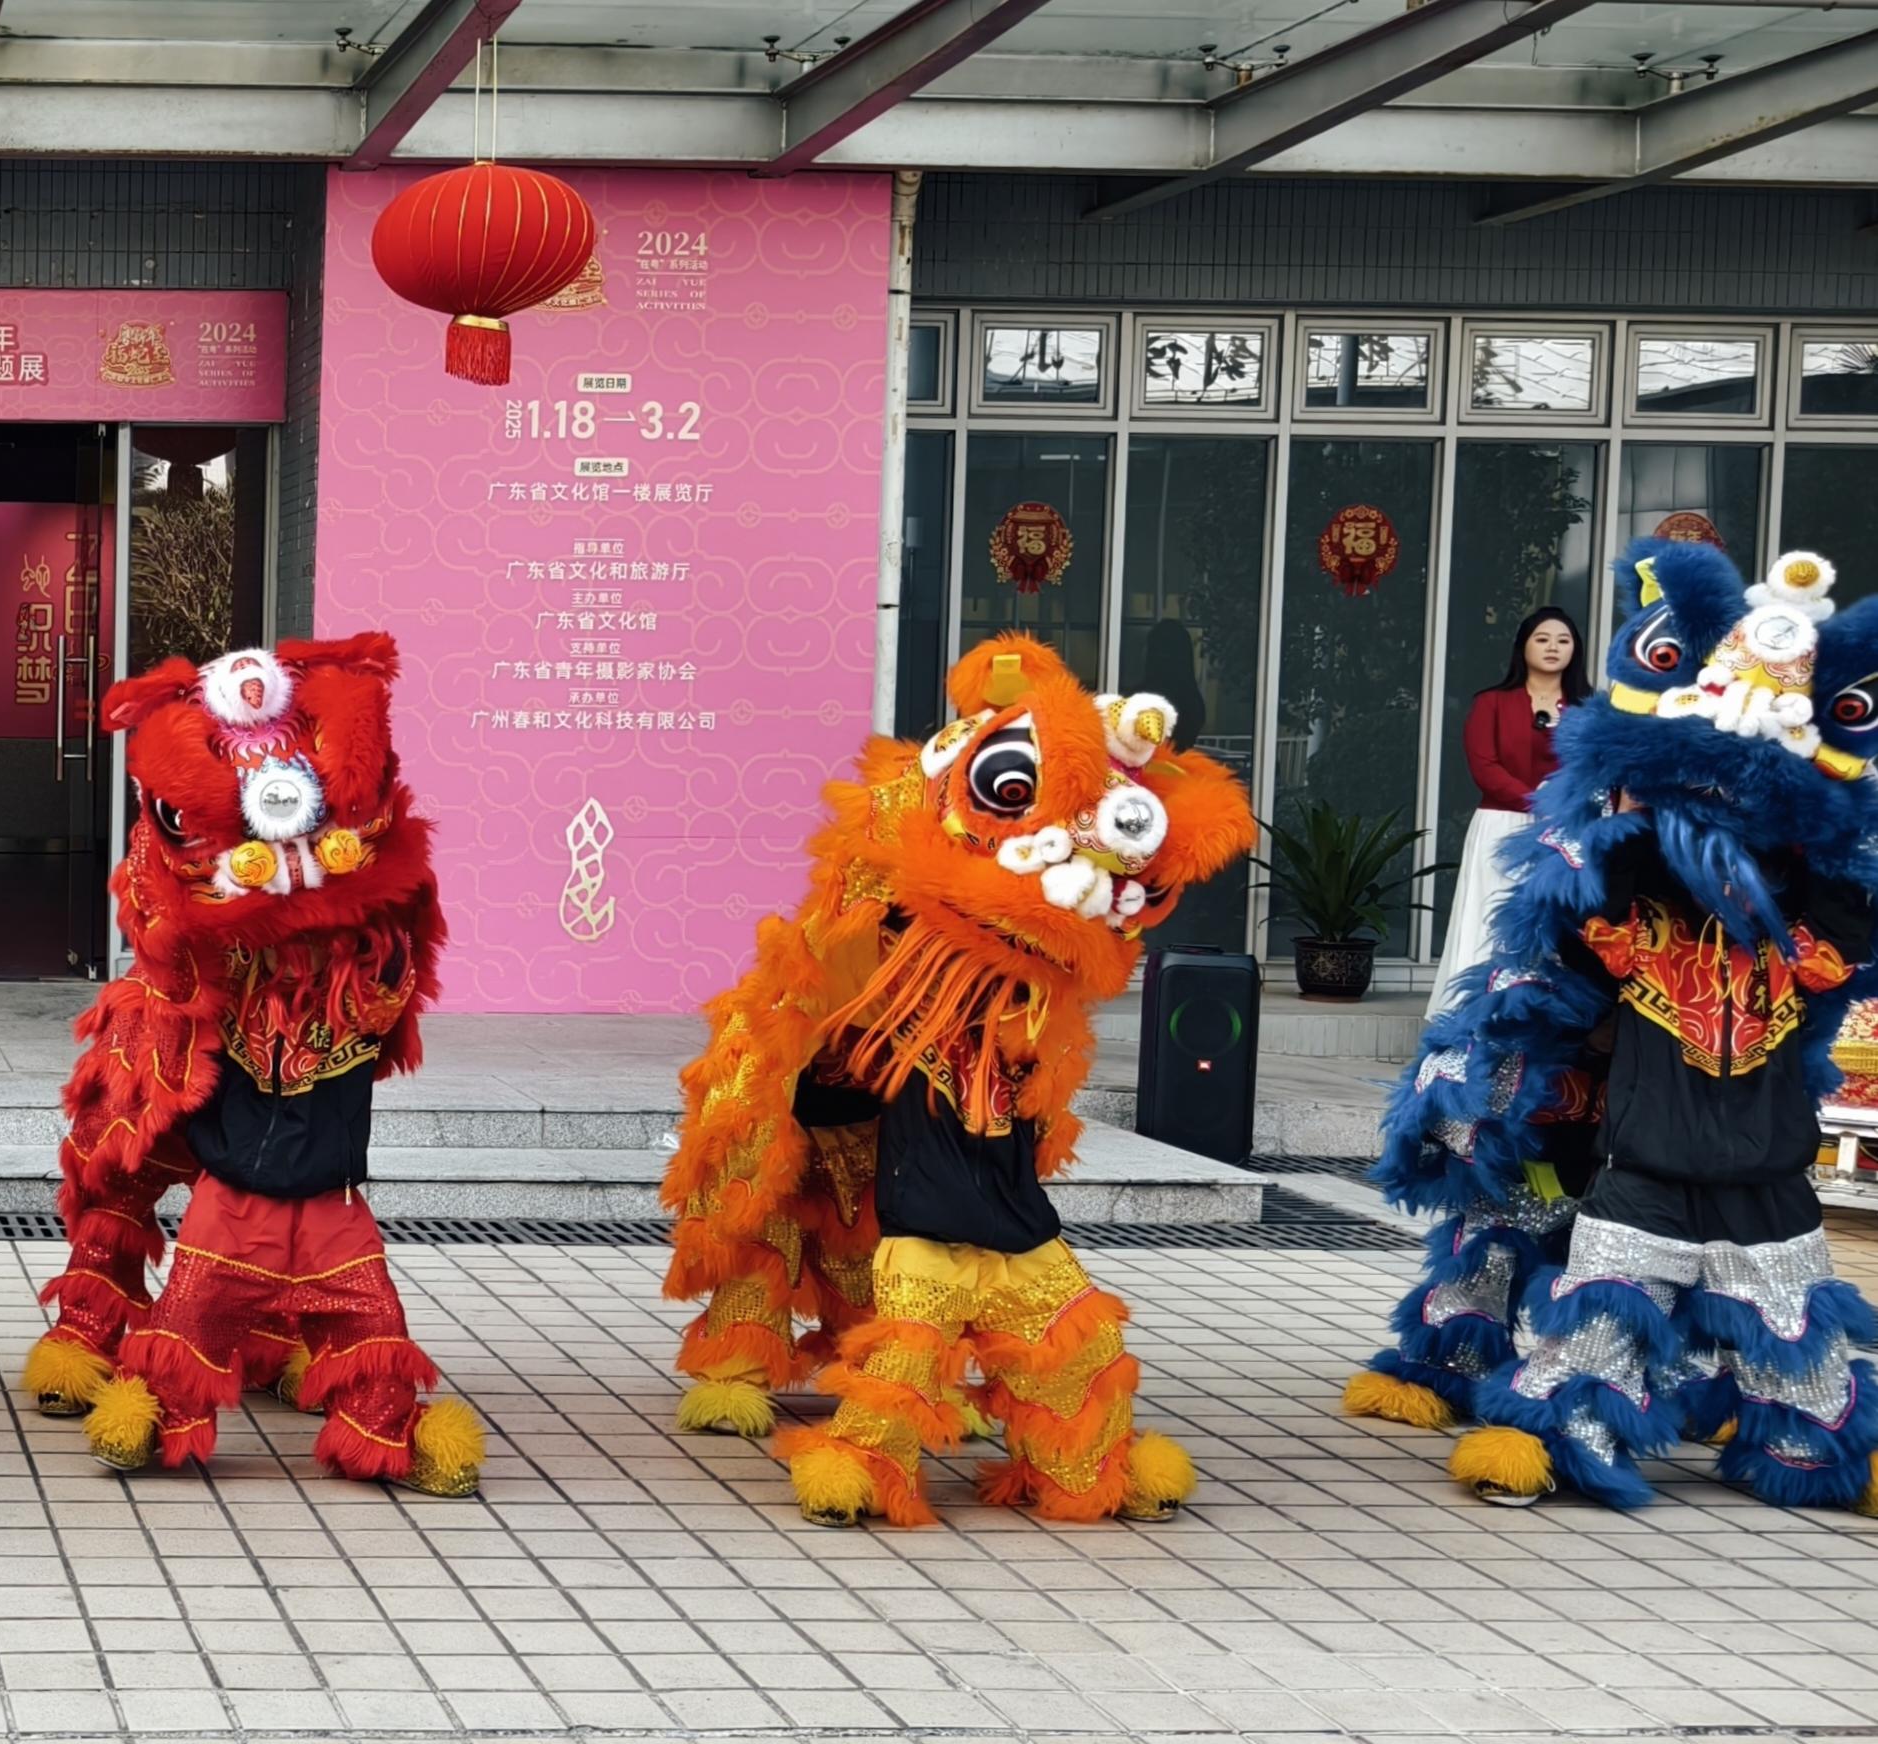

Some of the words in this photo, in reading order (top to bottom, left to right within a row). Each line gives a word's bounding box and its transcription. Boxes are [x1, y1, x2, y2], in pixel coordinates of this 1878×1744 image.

[637, 231, 708, 256] 2024
[636, 278, 657, 286] ZAI
[682, 278, 707, 286] YUE
[636, 290, 678, 298] SERIES
[689, 290, 706, 298] OF
[636, 302, 707, 310] ACTIVITIES
[199, 322, 257, 342] 2024
[583, 377, 627, 389] 展览日期
[505, 399, 522, 439] 2025
[527, 400, 596, 440] 1.18
[640, 401, 701, 440] 3.2
[579, 461, 624, 473] 展览地点
[487, 482, 714, 502] 广东省文化馆一楼展览厅
[506, 561, 691, 581] 广东省文化和旅游厅
[572, 592, 623, 604] 主办单位
[535, 612, 657, 631] 广东省文化馆
[492, 661, 697, 681] 广东省青年摄影家协会
[569, 691, 619, 704] 承办单位
[470, 711, 717, 731] 广州春和文化科技有限公司
